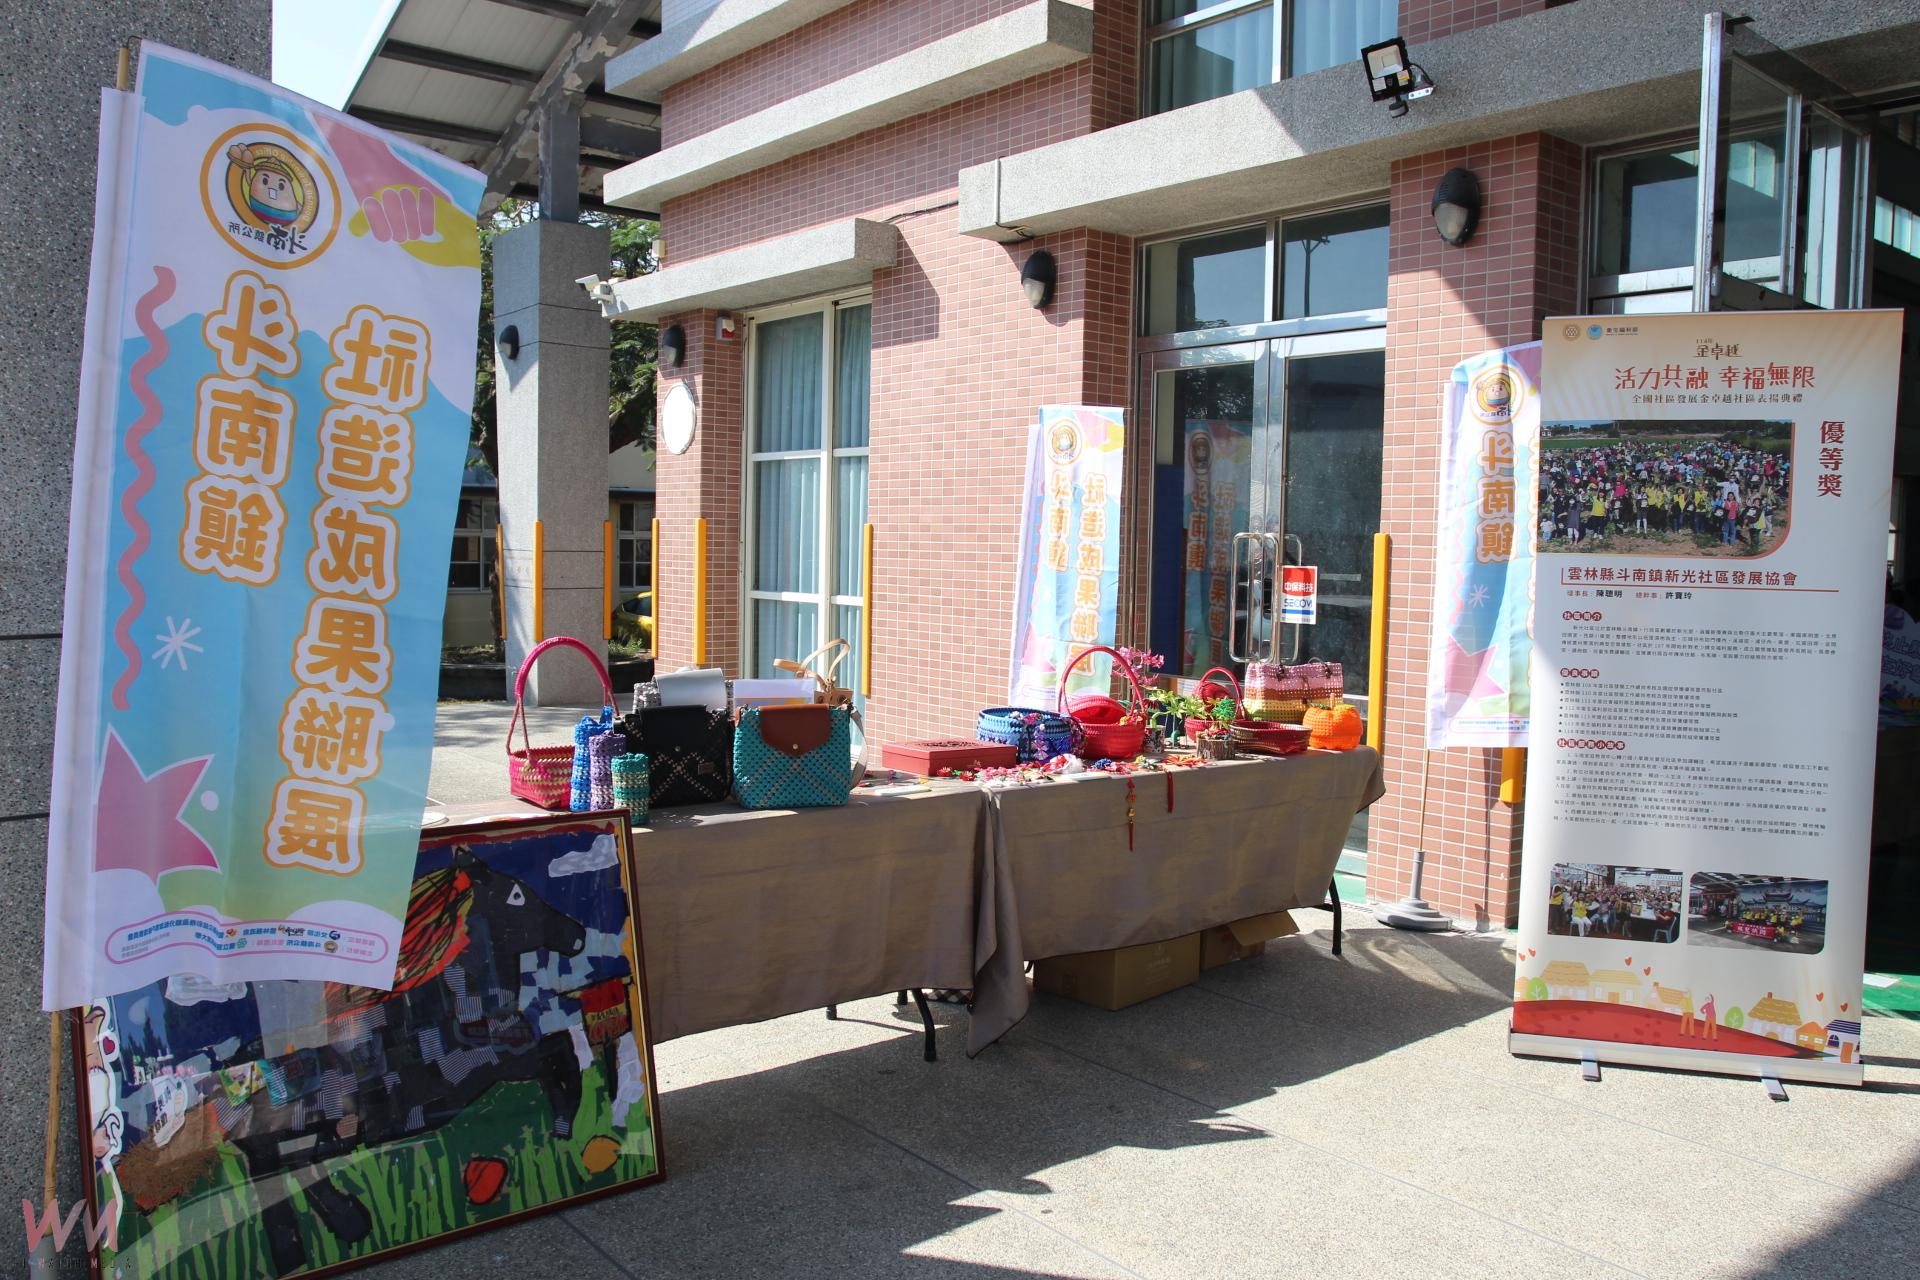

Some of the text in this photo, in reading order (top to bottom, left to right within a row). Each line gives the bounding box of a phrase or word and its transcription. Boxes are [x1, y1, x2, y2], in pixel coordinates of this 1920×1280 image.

[1694, 342, 1743, 360] 金卓越
[1614, 362, 1816, 390] 活力共融 幸福無限
[1818, 420, 1846, 498] 優等獎
[1567, 566, 1798, 586] 雲林縣斗南鎮新光社區發展協會
[1284, 582, 1313, 593] 中保科技
[1284, 598, 1313, 609] SECOM
